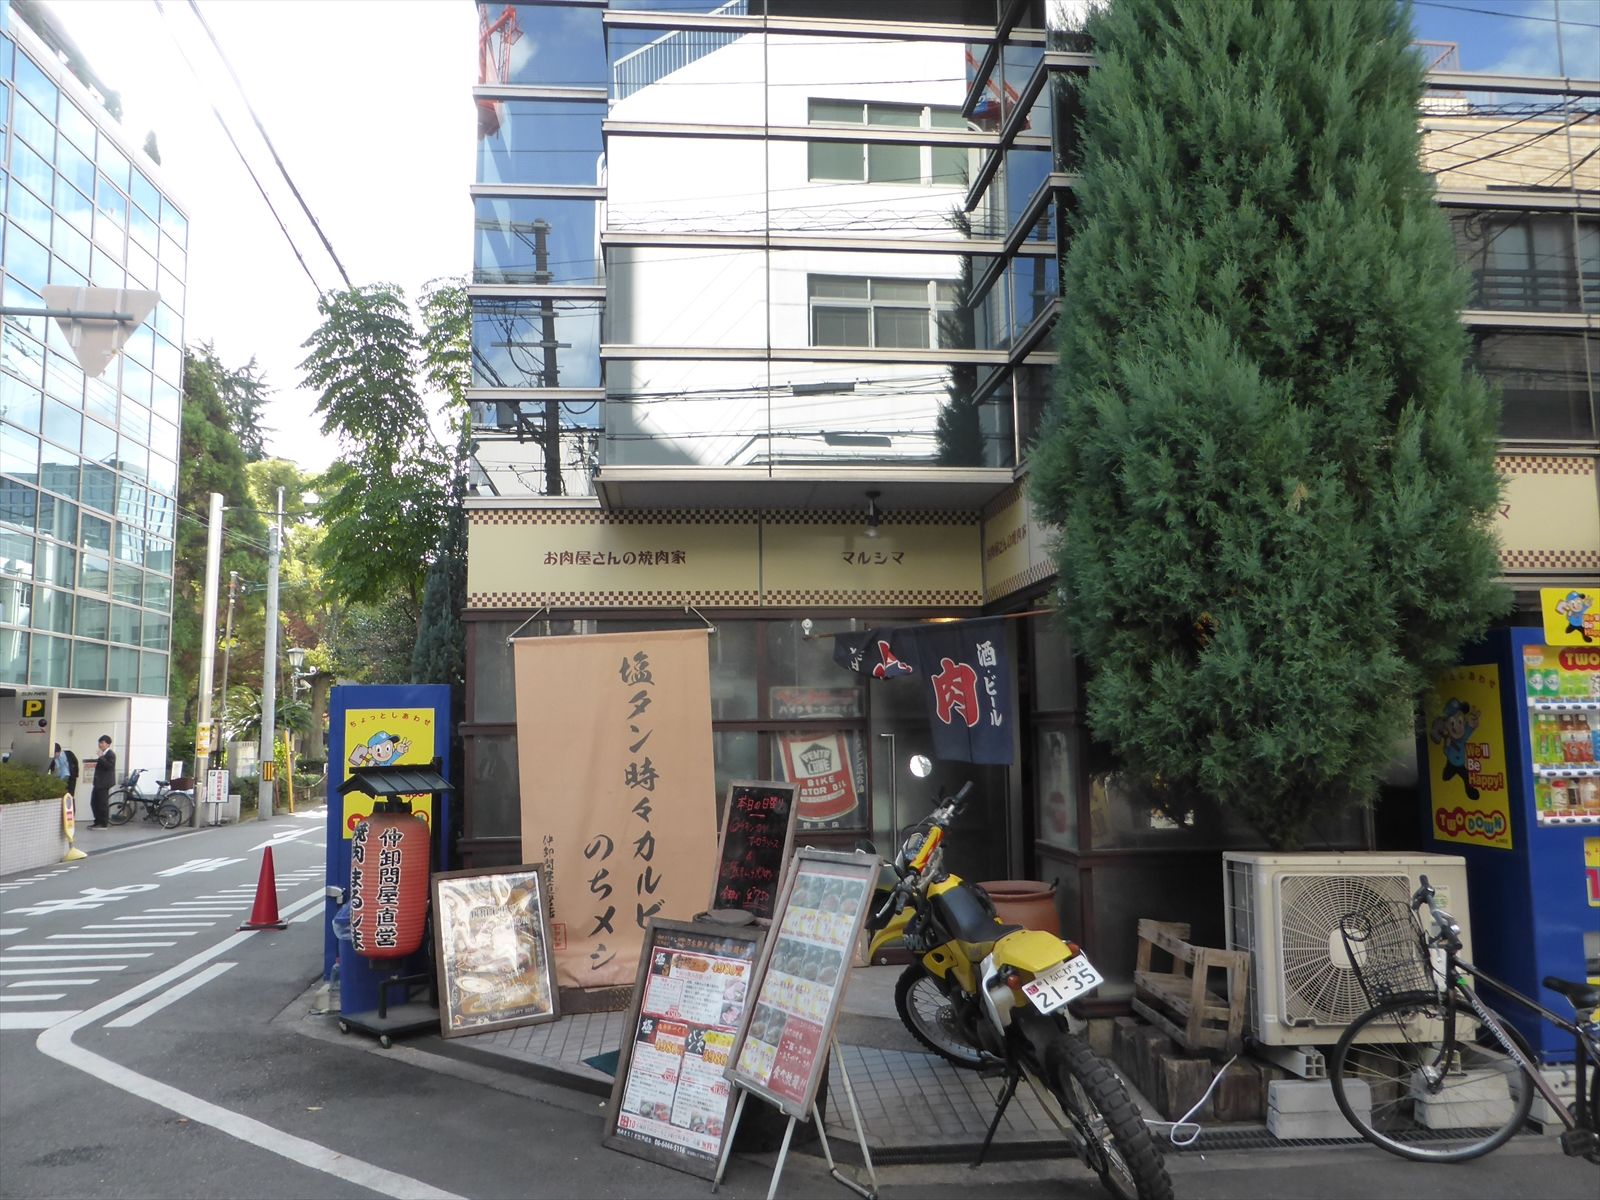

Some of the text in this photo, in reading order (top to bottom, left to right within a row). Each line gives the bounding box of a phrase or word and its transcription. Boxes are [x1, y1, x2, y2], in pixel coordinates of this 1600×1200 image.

[543, 550, 686, 566] お肉屋さんの焼肉家
[840, 551, 905, 565] マルシマ
[1565, 653, 1600, 666] TWO
[976, 641, 1002, 726] 酒・ビール
[931, 657, 980, 728] 肉
[26, 700, 42, 717] P
[350, 712, 431, 728] ちょっとしあわせ
[1466, 743, 1490, 758] We'll
[1467, 759, 1480, 771] Be
[801, 781, 847, 796] OTOR OIL
[807, 775, 835, 786] BIKE
[1468, 773, 1504, 791] Happy!
[618, 650, 665, 930] 塩タン時々カルビ
[1439, 812, 1504, 835] TWO DOWN
[375, 827, 403, 947] 仲卸問屋直営
[583, 833, 618, 972] のちメン
[1036, 968, 1096, 1008] 21-35
[1470, 999, 1526, 1069] SOUTHERNPORT
